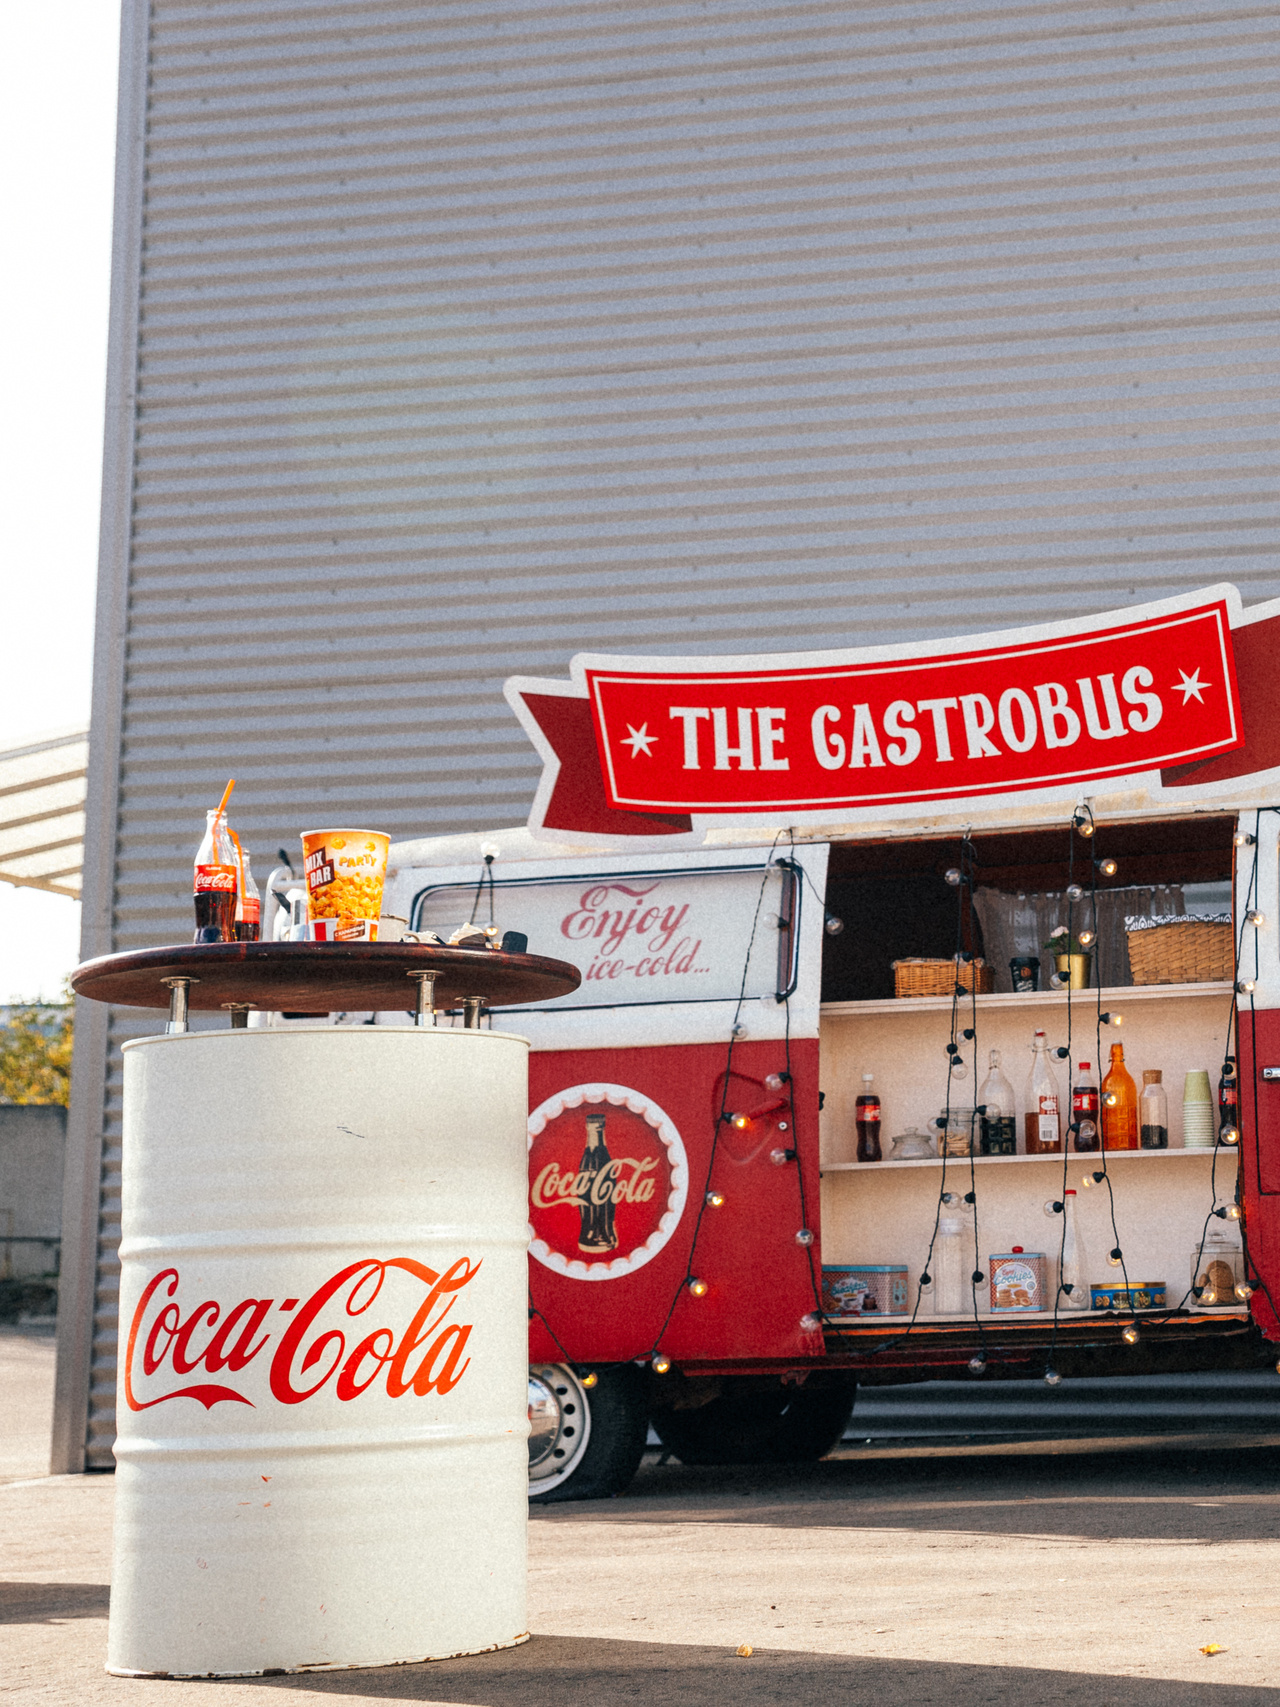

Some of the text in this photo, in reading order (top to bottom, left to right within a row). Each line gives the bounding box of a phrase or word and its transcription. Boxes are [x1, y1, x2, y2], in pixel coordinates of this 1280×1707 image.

[669, 665, 1164, 771] THE GASTROBUS
[195, 872, 235, 889] Coca-Cola
[305, 850, 324, 874] MIX
[309, 865, 332, 888] BAR
[338, 853, 378, 868] PARTY
[560, 881, 690, 956] Enjoy
[586, 936, 710, 981] ice-cold...
[531, 1156, 660, 1209] Coca-Cola
[125, 1256, 484, 1412] Coca-Cola
